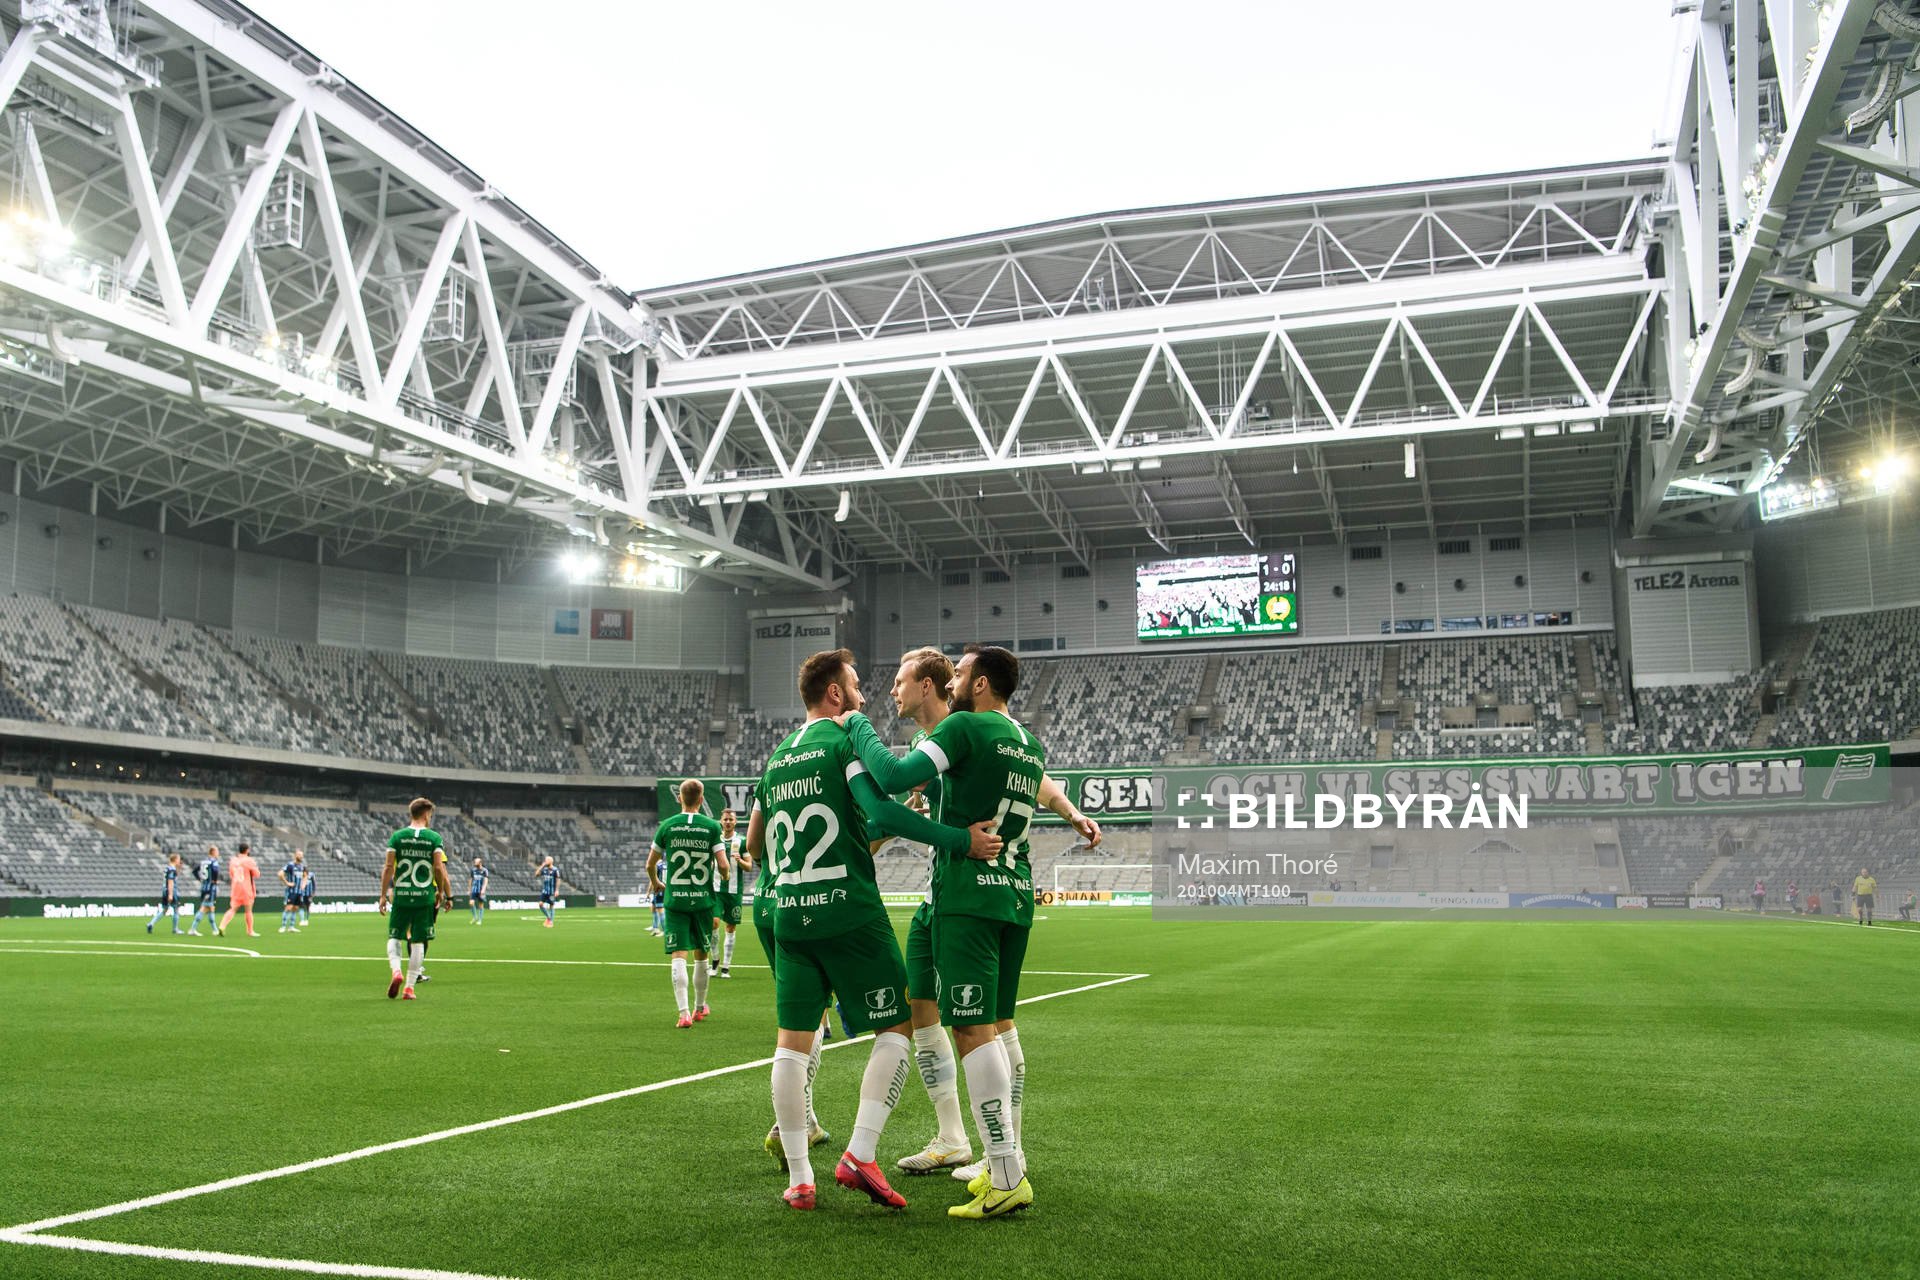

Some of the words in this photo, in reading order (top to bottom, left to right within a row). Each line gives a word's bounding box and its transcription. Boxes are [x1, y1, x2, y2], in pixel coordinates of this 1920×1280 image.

[1634, 571, 1686, 591] TELE2
[1688, 574, 1740, 589] Arena
[755, 622, 792, 639] TELE2
[794, 624, 831, 638] Arena
[788, 748, 826, 767] pantbank
[1083, 777, 1164, 811] SEN
[1209, 773, 1304, 808] OCH
[1320, 772, 1370, 807] VI
[1485, 766, 1659, 803] SNART
[1676, 759, 1803, 801] IGEN
[395, 858, 433, 888] 20
[669, 850, 710, 886] 23
[976, 874, 1011, 886] SILJA
[800, 893, 829, 907] LINE
[869, 1008, 898, 1020] fronta
[952, 1007, 983, 1016] fronta
